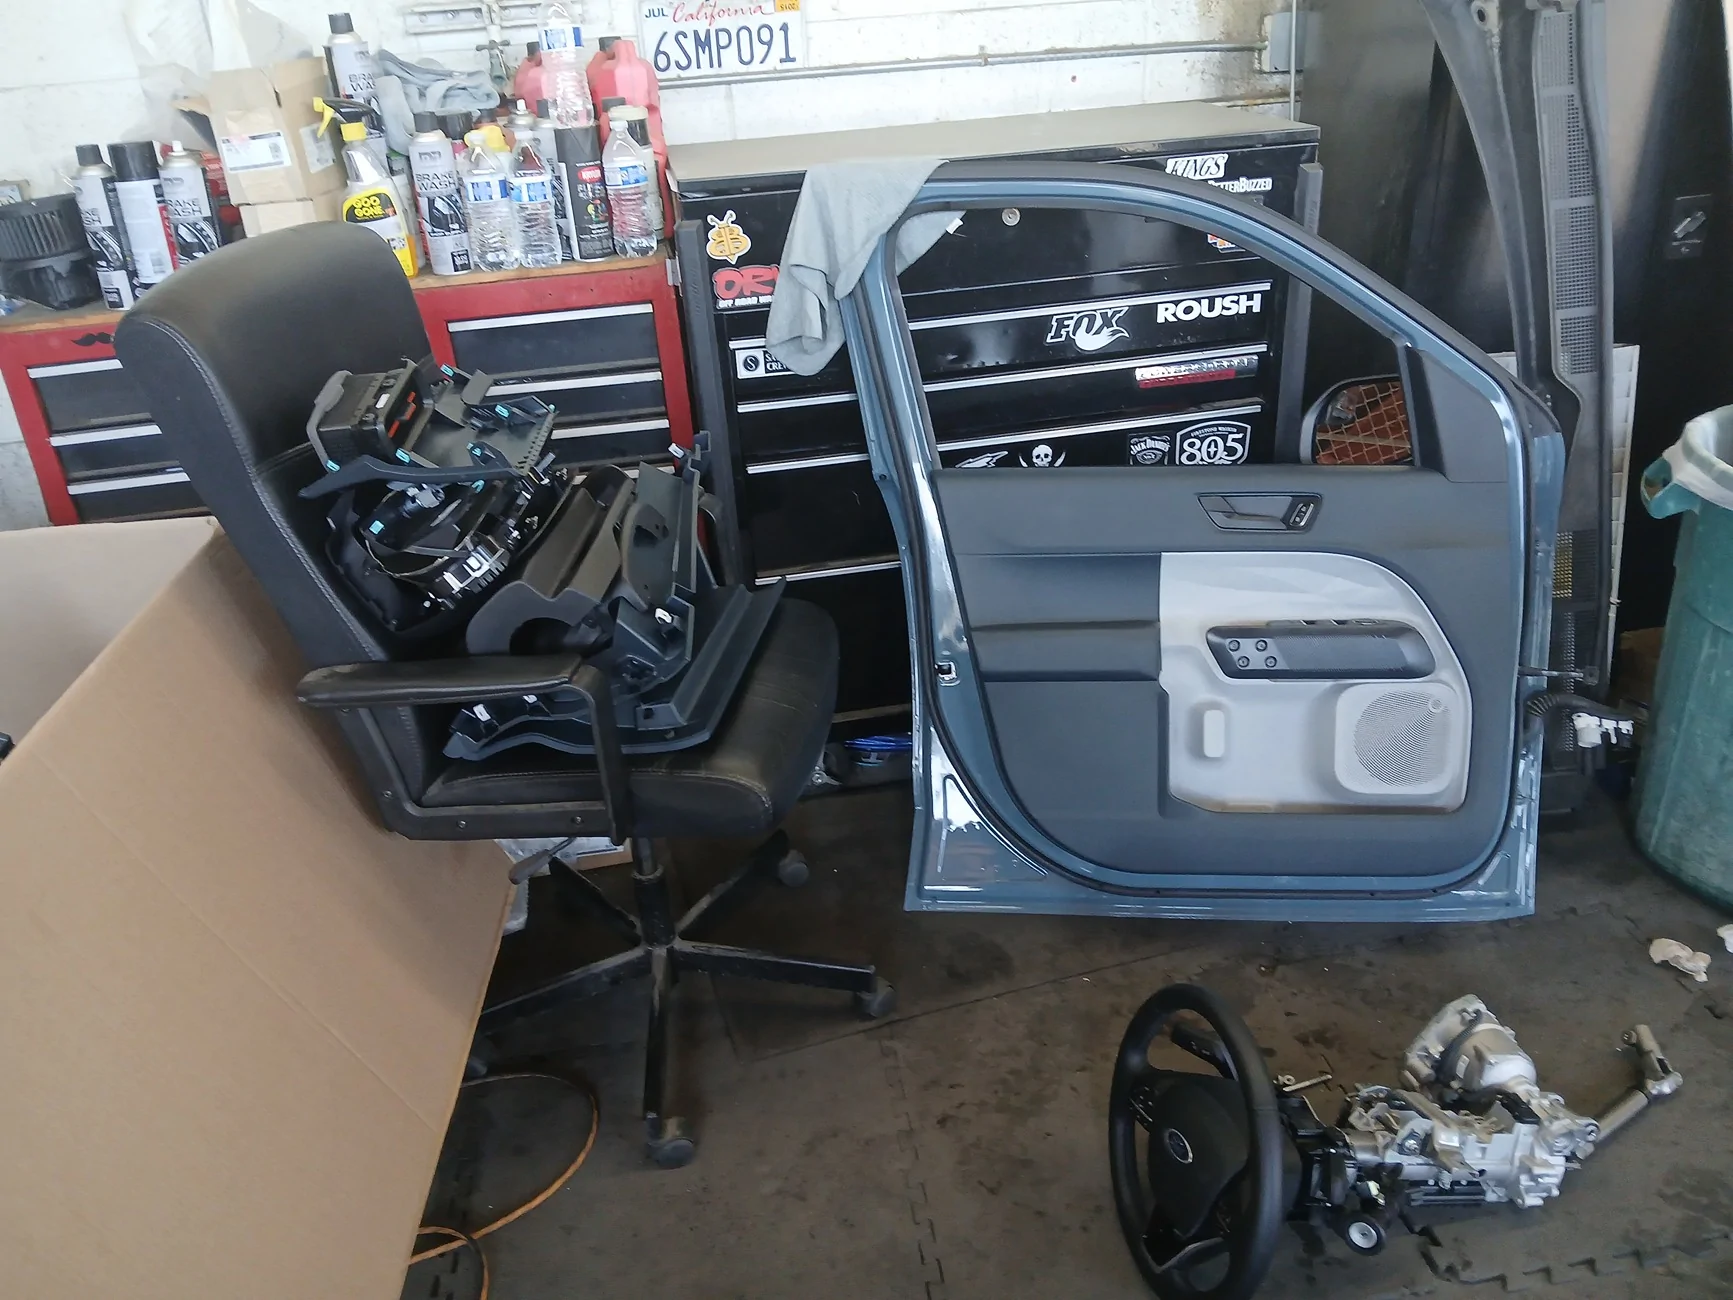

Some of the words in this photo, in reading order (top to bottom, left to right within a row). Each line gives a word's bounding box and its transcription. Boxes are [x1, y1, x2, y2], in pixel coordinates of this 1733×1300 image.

[645, 7, 669, 18] JUL
[672, 0, 775, 26] California
[653, 21, 797, 72] 6SMP091
[348, 72, 374, 83] BRA
[415, 170, 454, 182] BRAKE
[418, 180, 456, 191] WASH
[167, 198, 199, 208] RAKE
[353, 196, 381, 208] GOO
[173, 207, 203, 216] ASH
[354, 205, 384, 217] GONE
[712, 264, 779, 299] OR
[1157, 293, 1262, 323] ROUSH
[1046, 306, 1129, 345] FOX
[1180, 432, 1245, 465] 805
